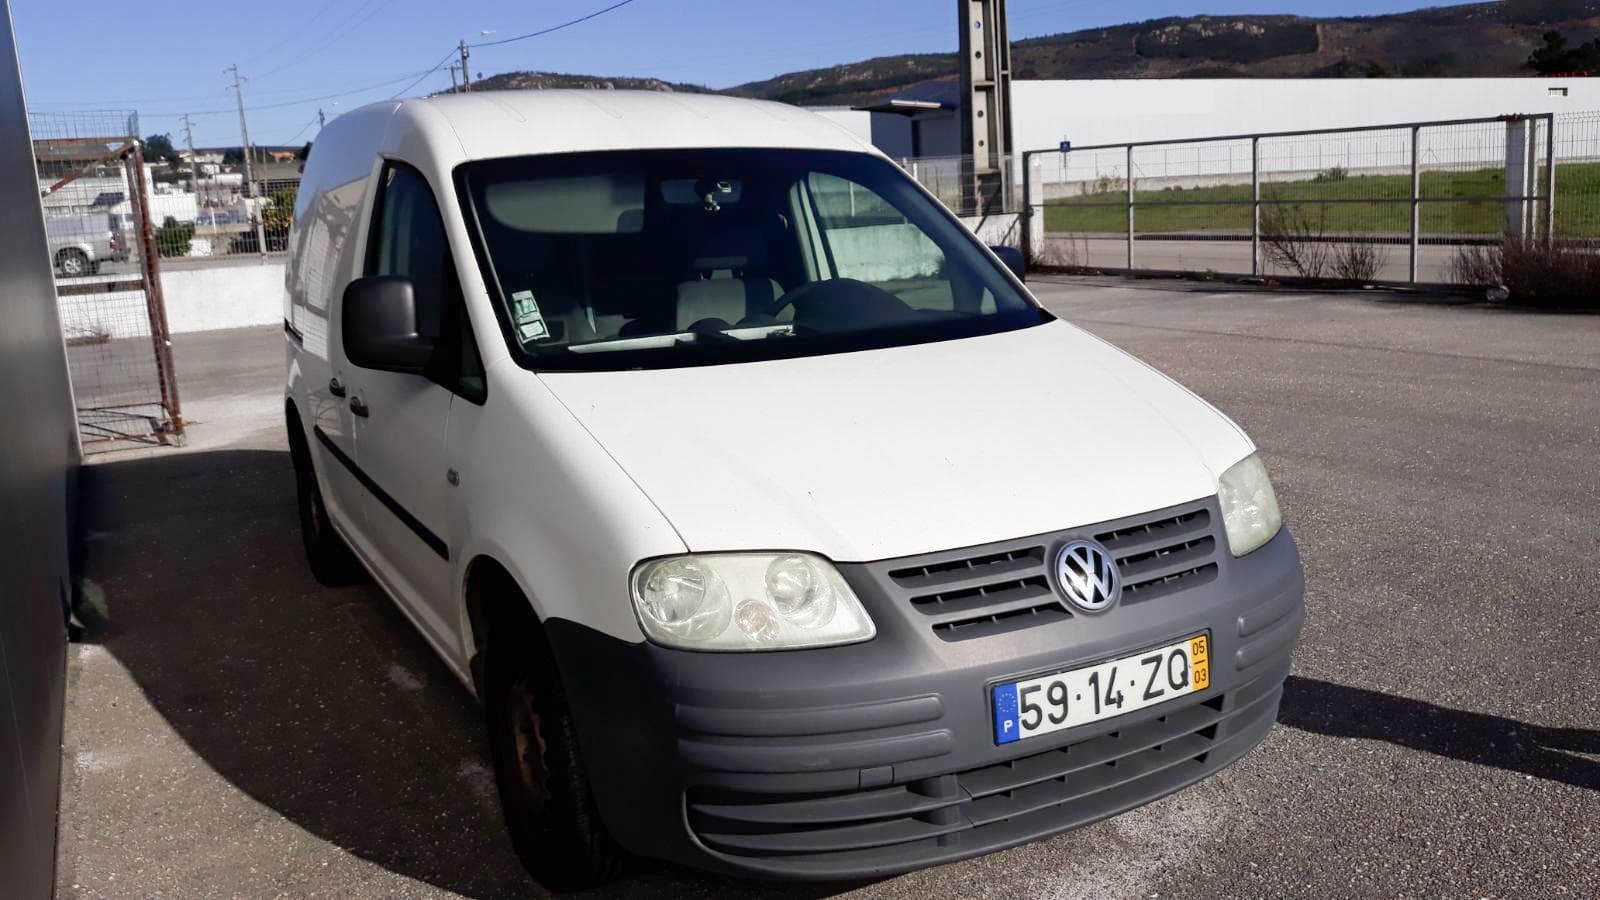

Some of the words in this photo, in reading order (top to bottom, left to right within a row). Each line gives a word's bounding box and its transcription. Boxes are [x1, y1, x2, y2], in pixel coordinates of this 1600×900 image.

[1058, 543, 1116, 608] VW
[1192, 639, 1205, 656] 05
[1194, 668, 1207, 685] 03
[1003, 719, 1013, 733] P
